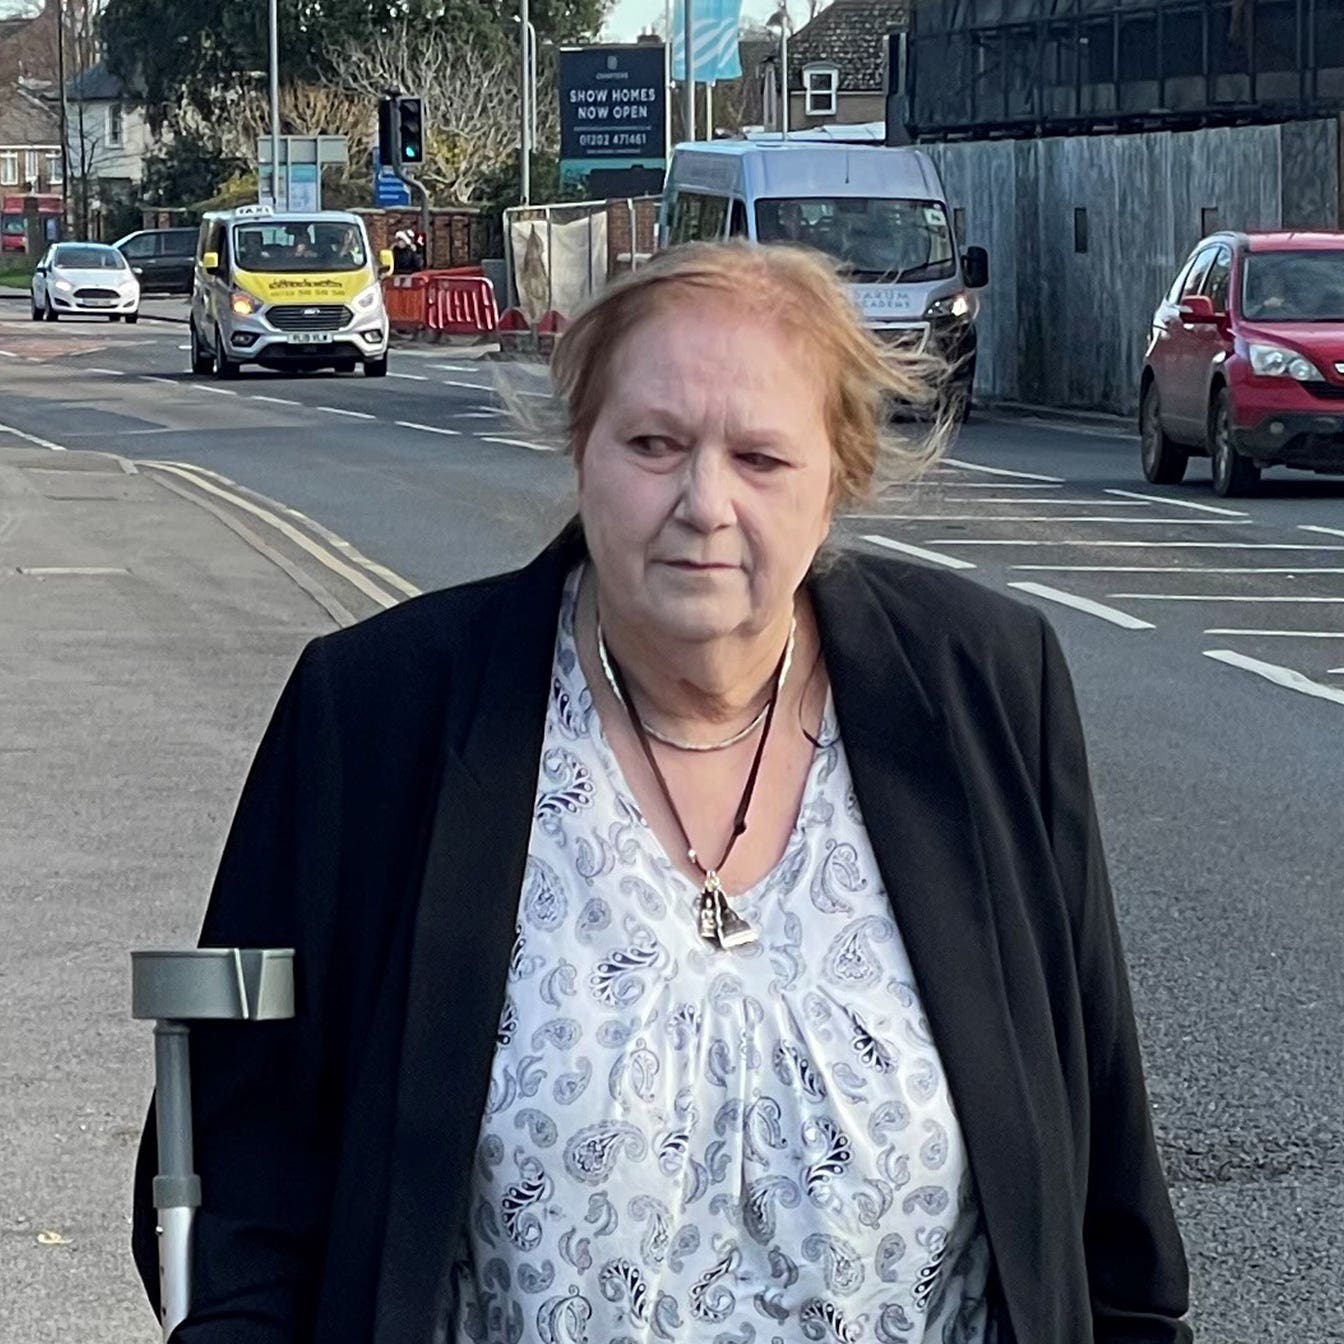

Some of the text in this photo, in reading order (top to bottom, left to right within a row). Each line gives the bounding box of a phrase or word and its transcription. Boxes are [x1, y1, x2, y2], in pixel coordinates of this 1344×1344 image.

[570, 88, 656, 103] SHOW HOMES
[578, 106, 647, 119] NOW OPEN
[580, 134, 609, 146] 01202
